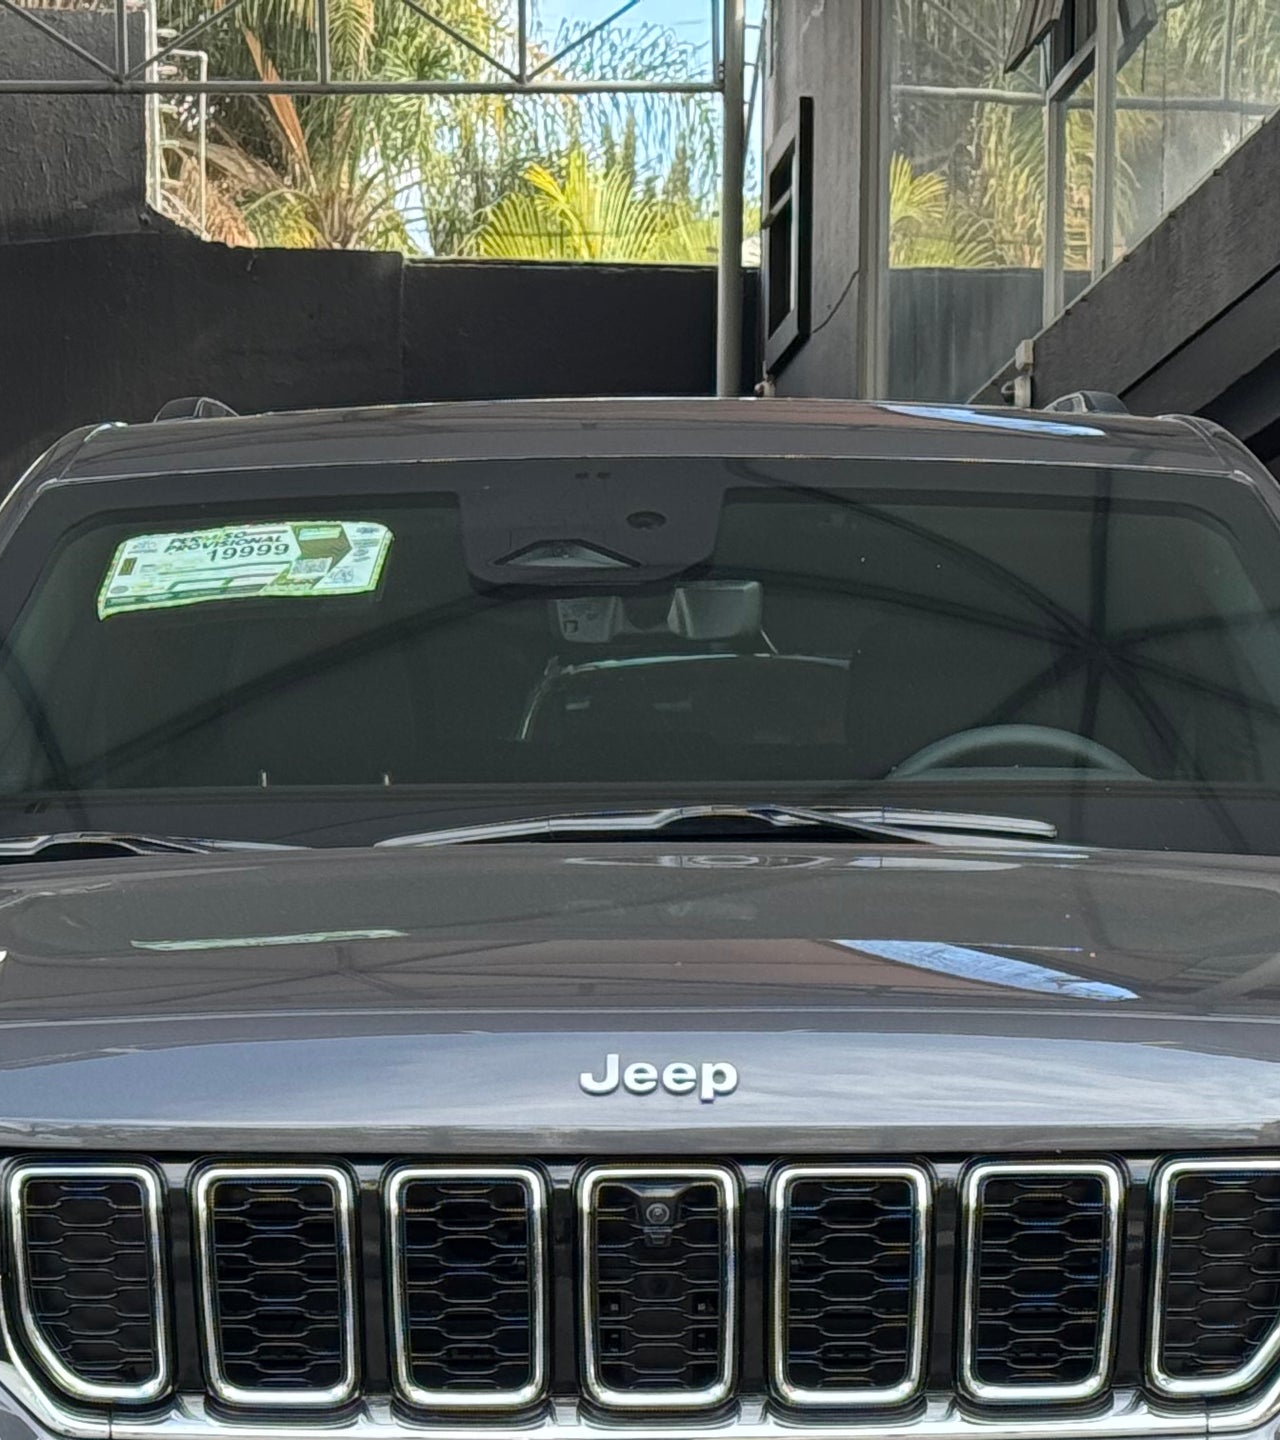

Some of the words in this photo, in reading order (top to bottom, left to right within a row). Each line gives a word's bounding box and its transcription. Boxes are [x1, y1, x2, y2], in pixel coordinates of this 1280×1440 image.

[163, 534, 283, 553] PROVISIONAL
[206, 543, 290, 562] 19999
[579, 1052, 740, 1103] Jeep
